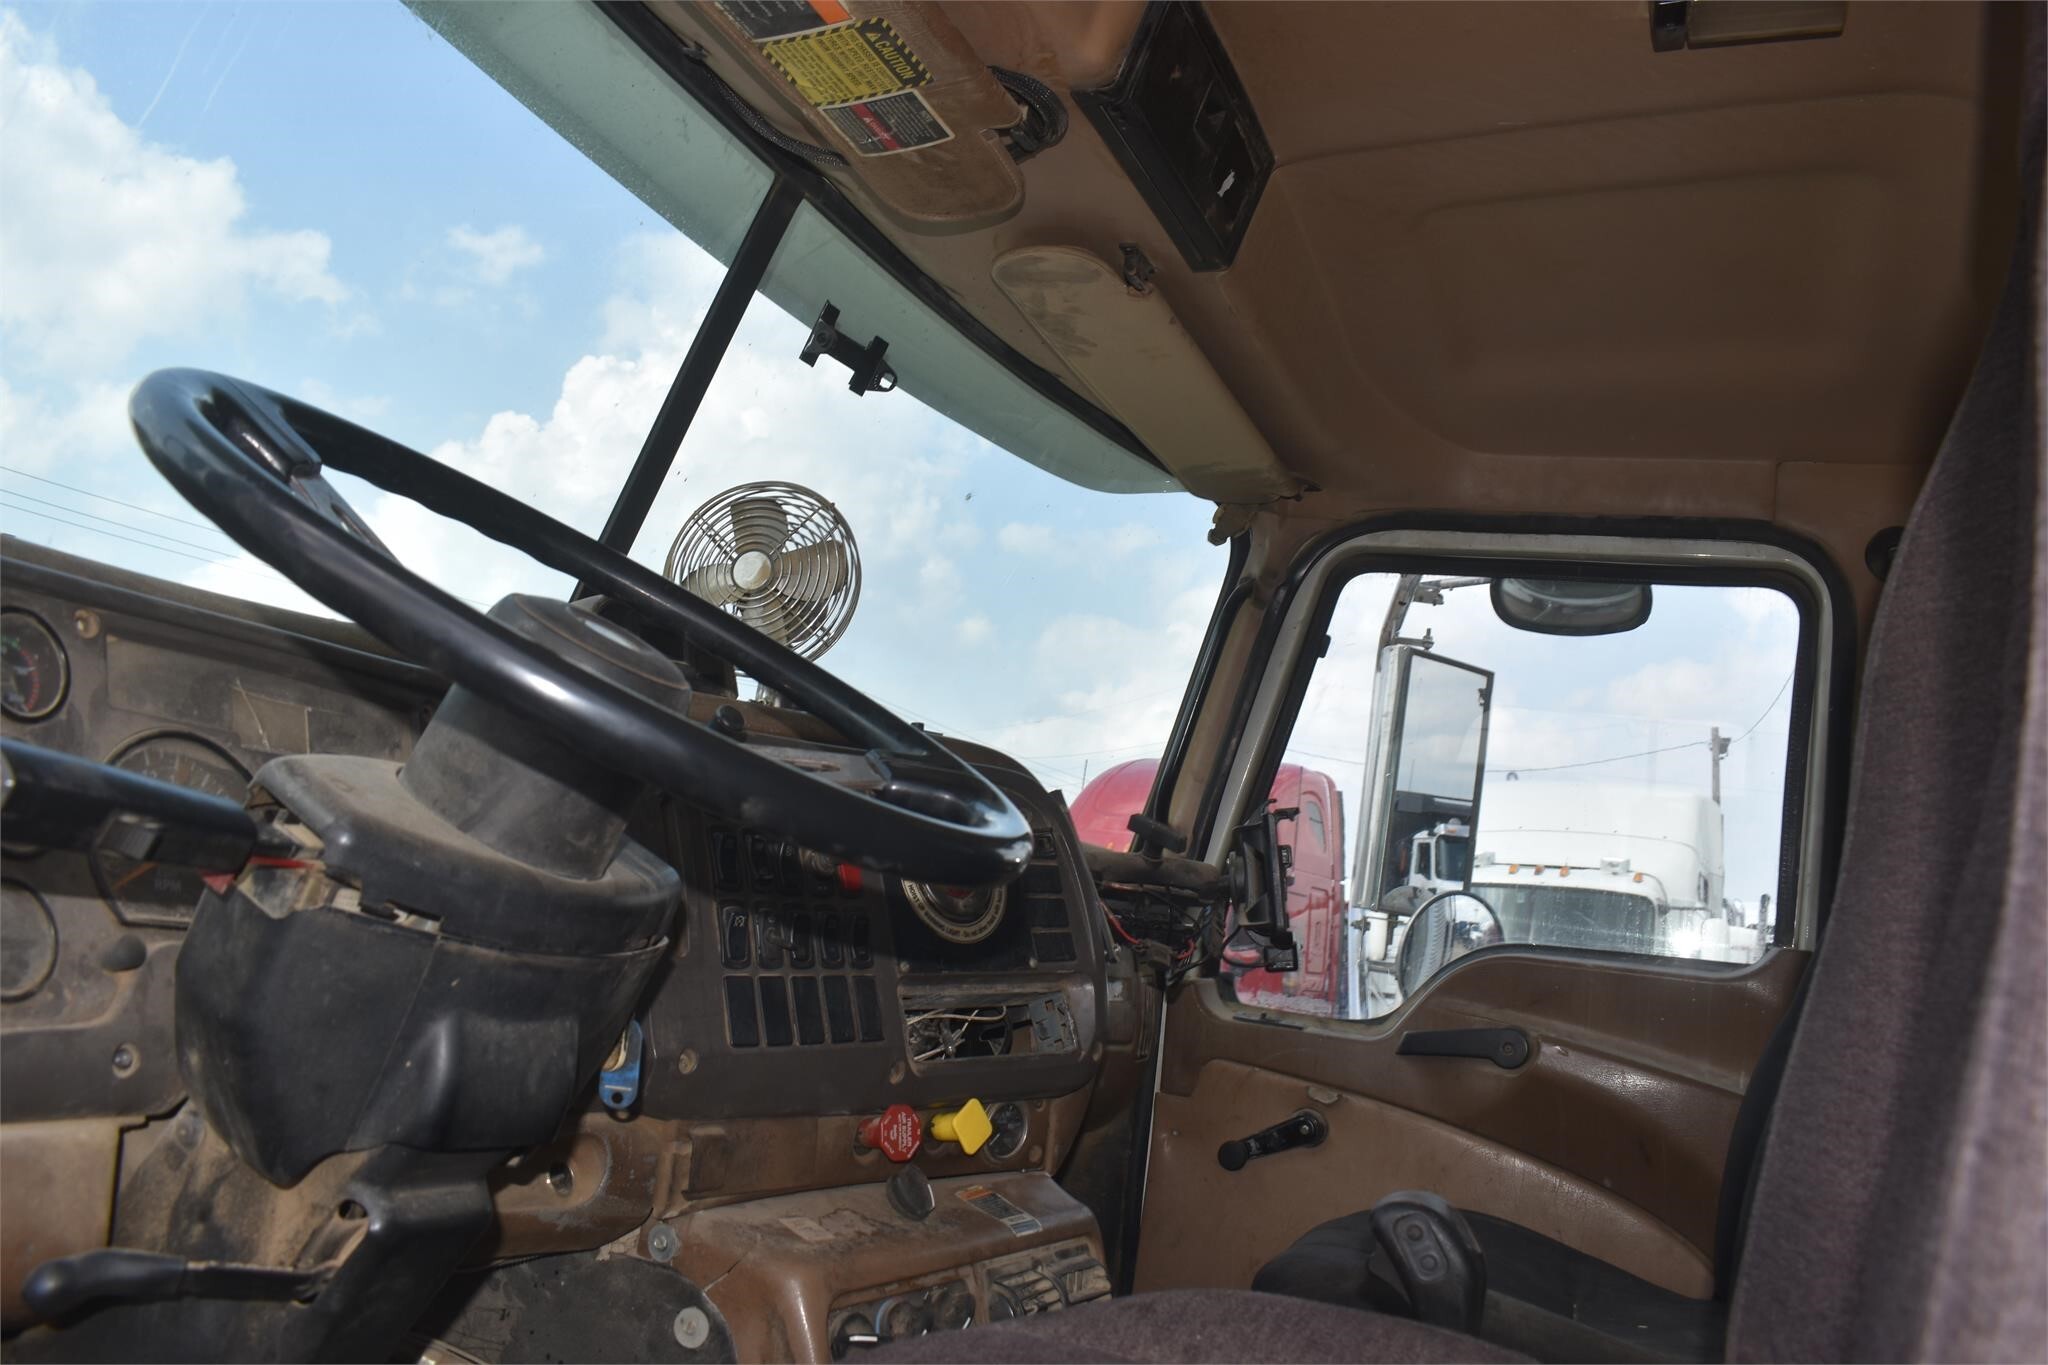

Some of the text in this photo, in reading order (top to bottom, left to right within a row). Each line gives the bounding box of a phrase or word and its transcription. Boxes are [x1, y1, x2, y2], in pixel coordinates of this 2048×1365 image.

[875, 41, 916, 79] CAUTION
[154, 878, 182, 893] RPM
[907, 884, 919, 903] HOIST
